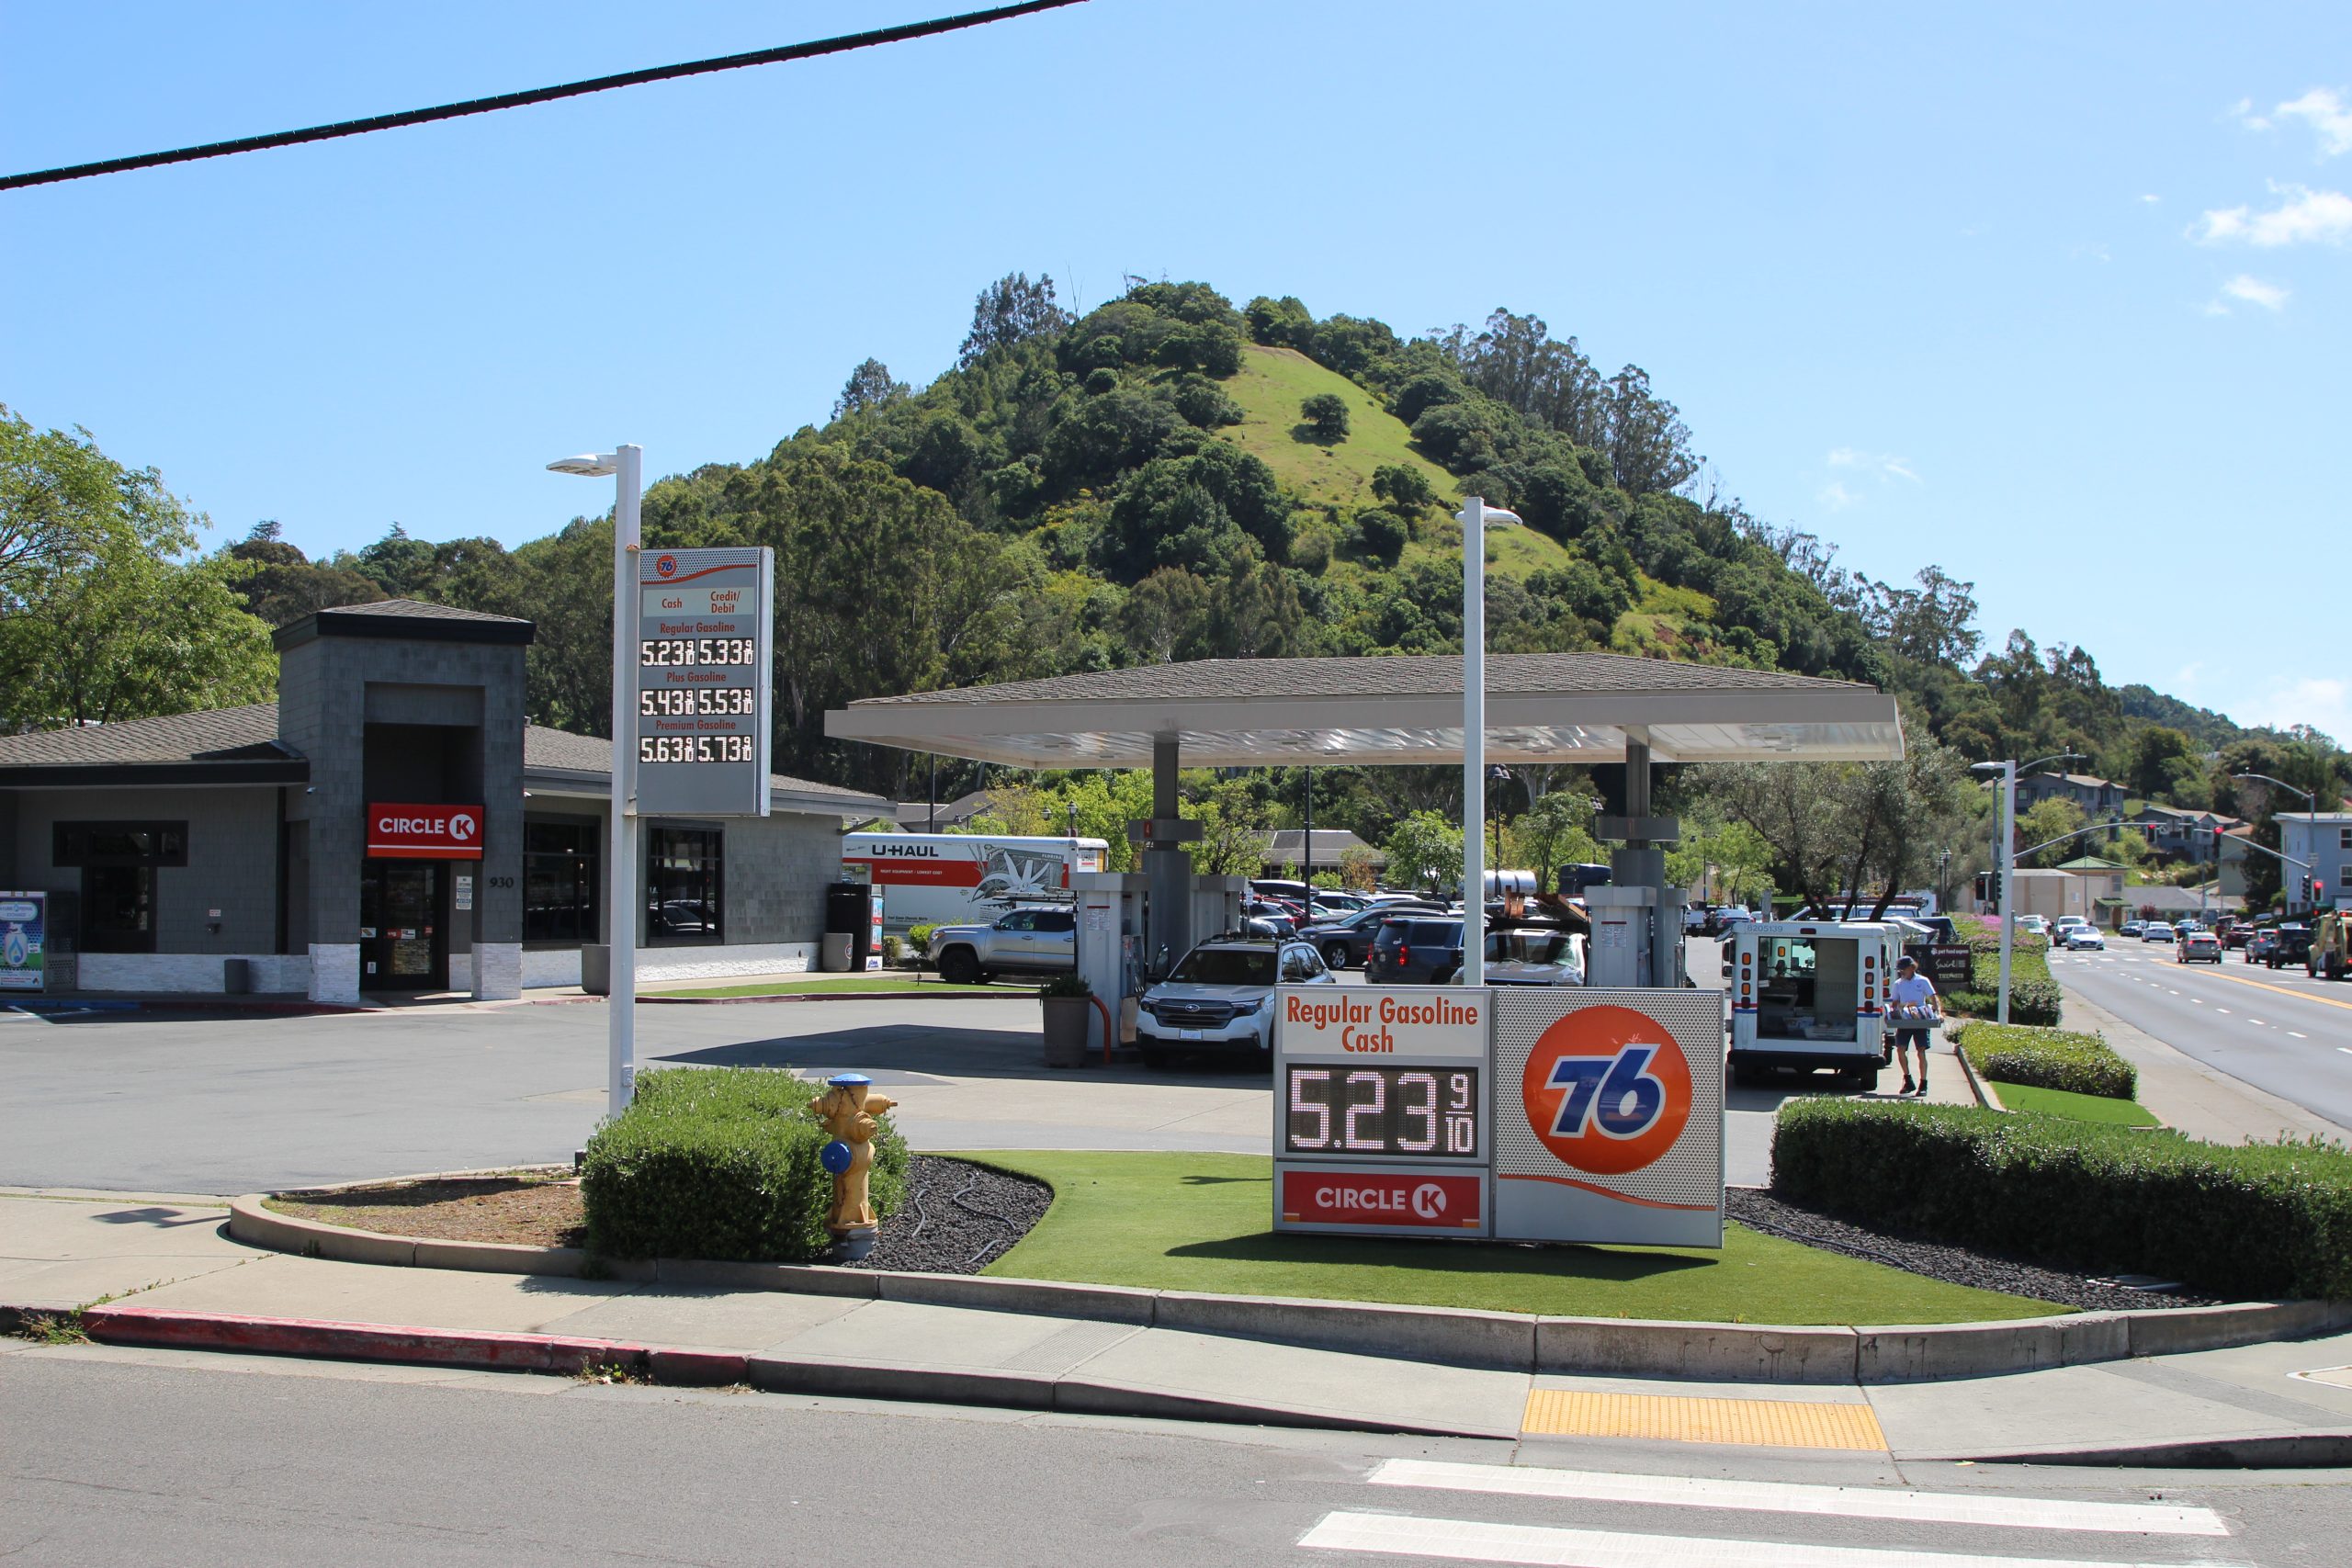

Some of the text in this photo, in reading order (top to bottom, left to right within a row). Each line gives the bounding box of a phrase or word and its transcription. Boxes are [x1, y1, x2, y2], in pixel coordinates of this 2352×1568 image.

[661, 561, 673, 571] 76
[710, 591, 741, 602] Credit/
[662, 598, 683, 609] Cash
[711, 604, 735, 614] Debit
[660, 622, 735, 636] Regular Gasoline
[667, 671, 727, 682] Plus Gasoline
[656, 719, 736, 730] Premium Gasoline
[379, 816, 474, 838] CIRCLE K
[872, 844, 939, 857] U-HAUL
[490, 876, 514, 888] 930
[1747, 924, 1783, 932] 8205139
[1287, 995, 1478, 1030] Regular Gasoline
[1341, 1025, 1394, 1054] Cash
[1543, 1043, 1667, 1141] 76
[1315, 1186, 1447, 1218] CIRCLE K
